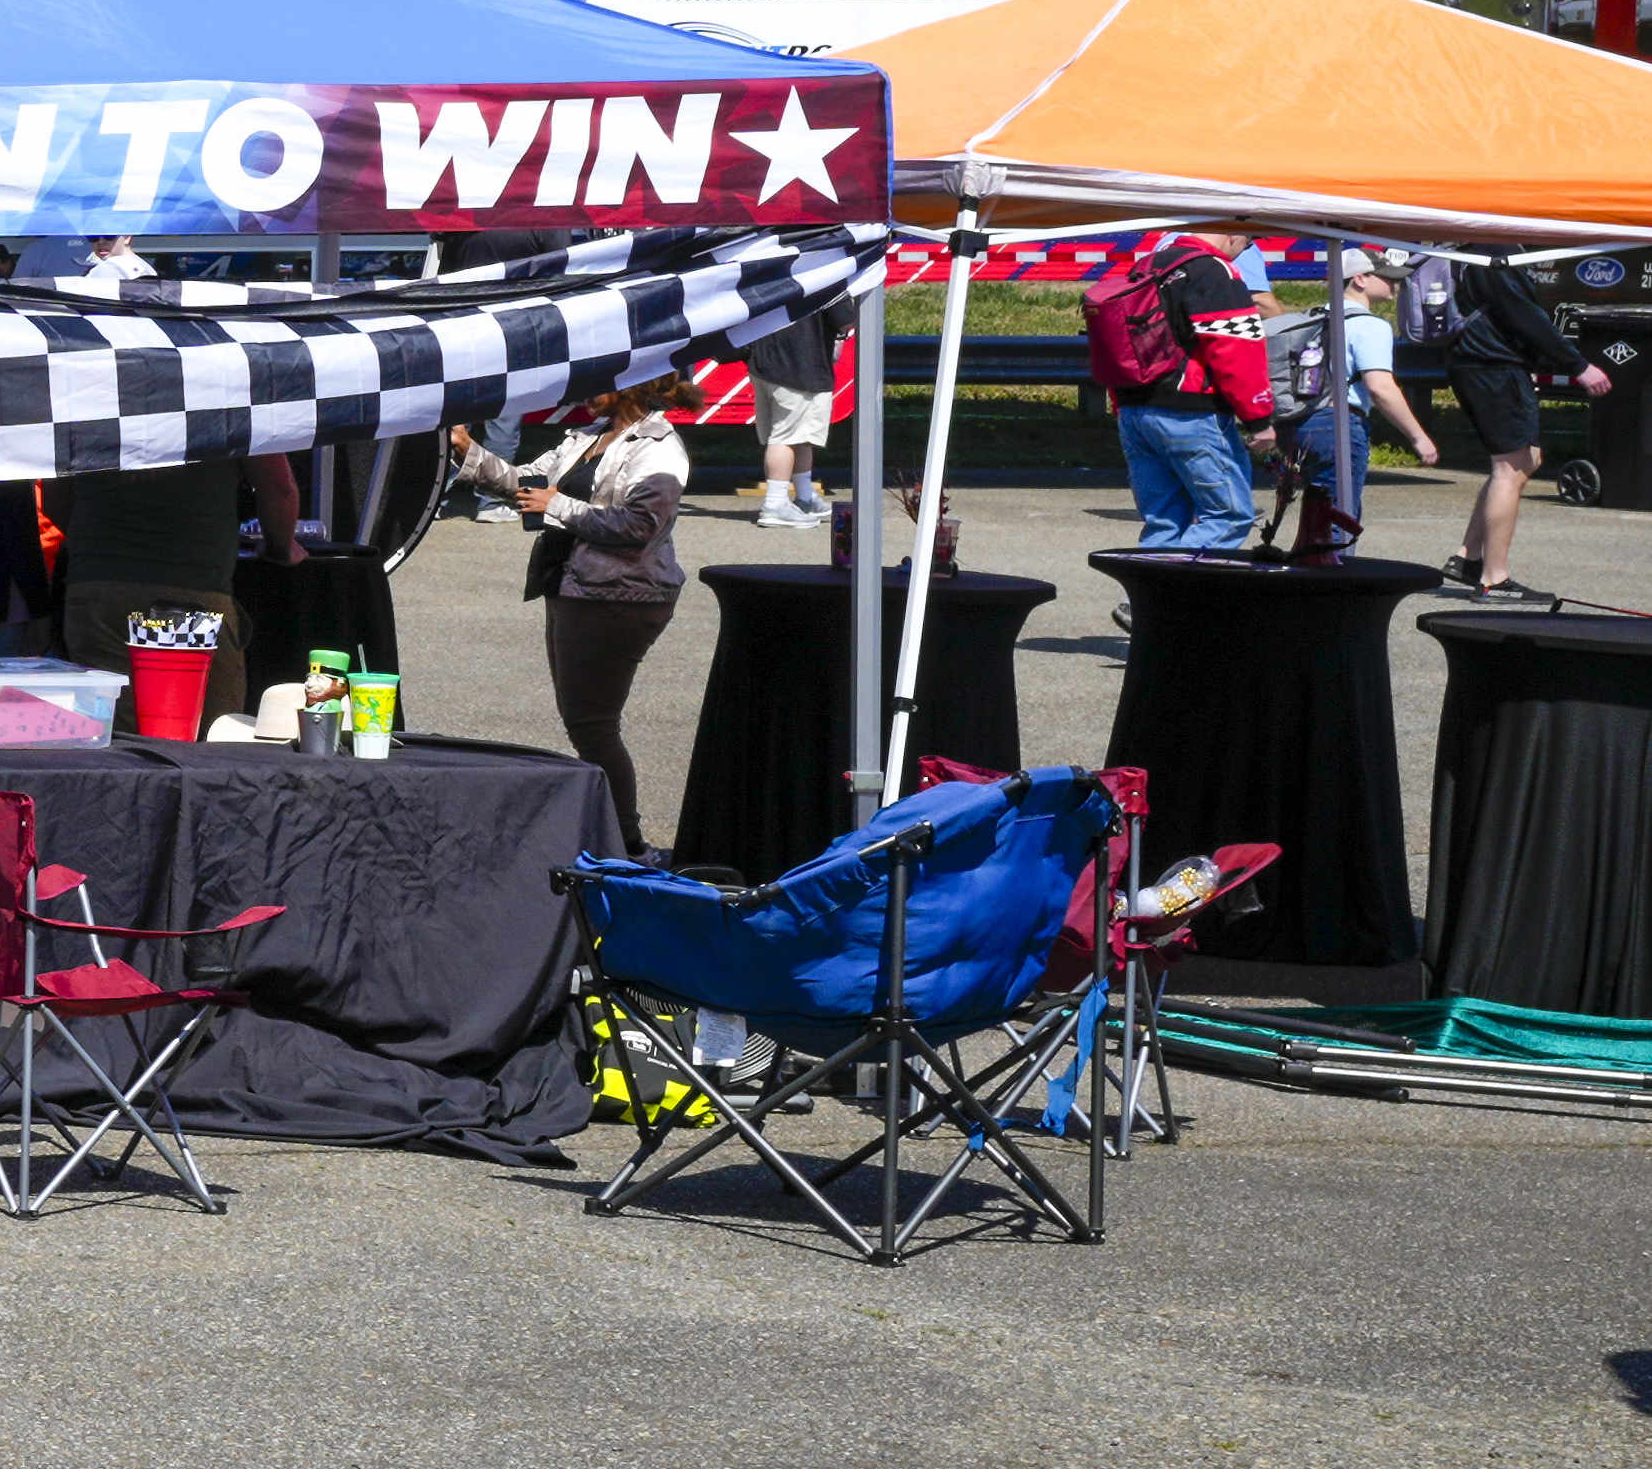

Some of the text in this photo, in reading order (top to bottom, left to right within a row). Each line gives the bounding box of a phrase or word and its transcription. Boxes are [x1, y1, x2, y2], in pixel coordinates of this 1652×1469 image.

[99, 97, 326, 213] TO
[376, 93, 755, 211] WIN
[1581, 260, 1618, 283] Ford
